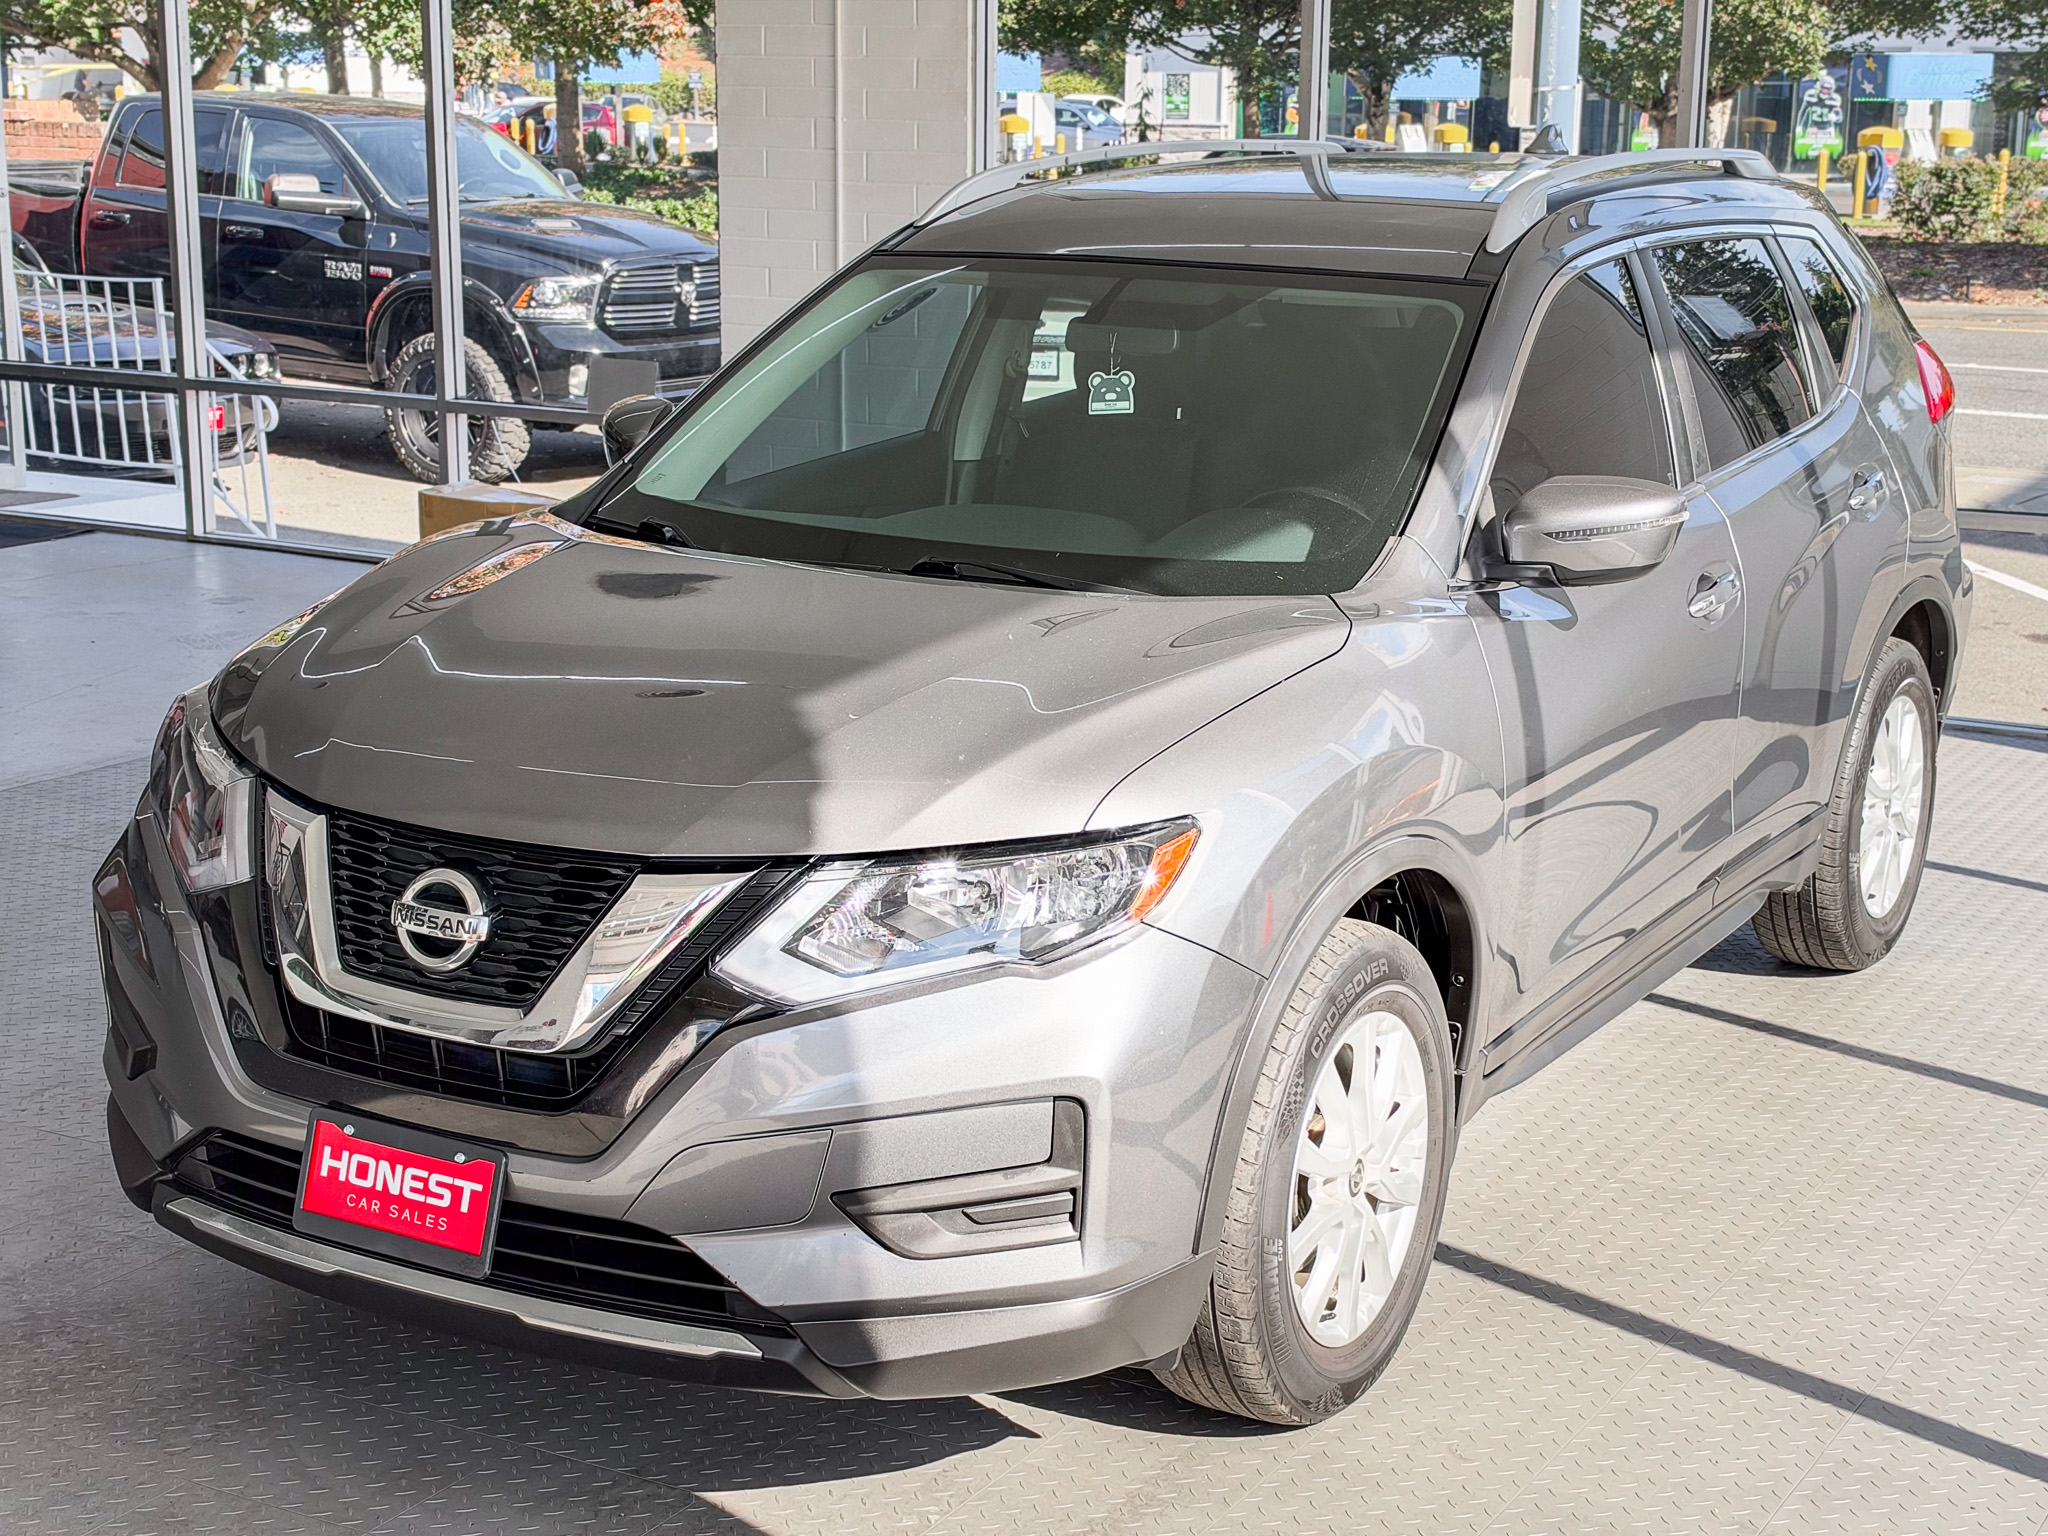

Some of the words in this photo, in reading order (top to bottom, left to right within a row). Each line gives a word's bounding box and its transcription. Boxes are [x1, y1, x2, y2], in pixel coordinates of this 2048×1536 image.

[324, 260, 362, 272] RAM
[324, 269, 362, 280] 1500
[394, 905, 475, 935] NISSAN
[1310, 957, 1389, 1060] CROSSOVER
[319, 1145, 484, 1214] HONEST
[346, 1193, 381, 1214] CAR
[388, 1205, 448, 1231] SALES
